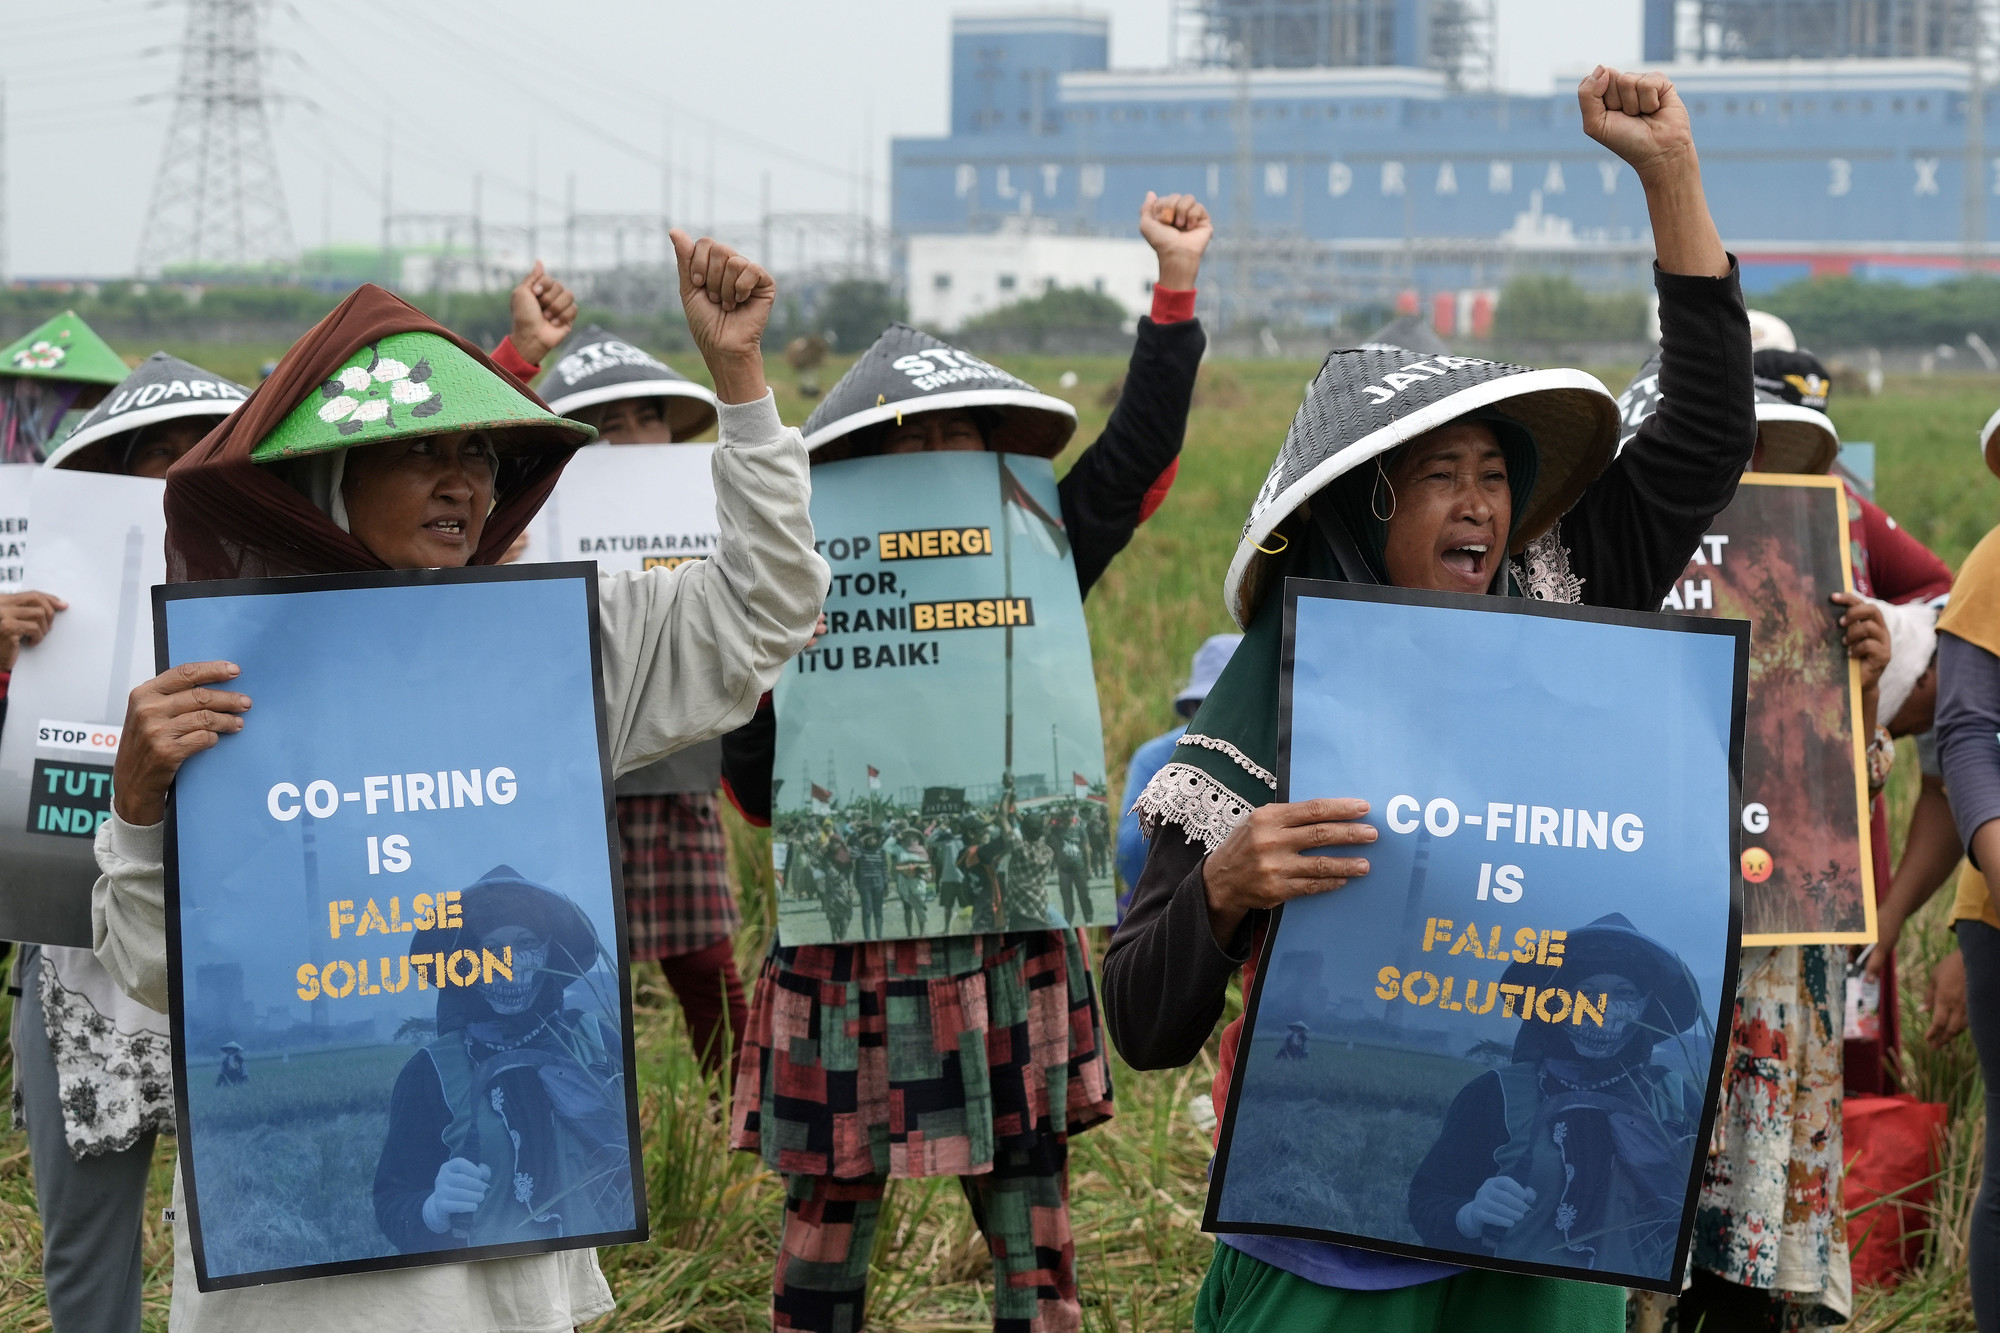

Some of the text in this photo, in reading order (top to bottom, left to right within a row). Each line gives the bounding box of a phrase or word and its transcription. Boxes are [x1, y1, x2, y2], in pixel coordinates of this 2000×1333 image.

[955, 163, 1106, 199] PLTU
[879, 528, 992, 559] ENERGI
[826, 572, 906, 599] TOR,
[914, 600, 1028, 630] BERSIH
[853, 641, 939, 669] BAIK!
[40, 728, 86, 744] STOP
[44, 768, 115, 798] TUT
[267, 767, 517, 821] CO-FIRING
[1386, 794, 1644, 852] CO-FIRING
[367, 834, 412, 874] IS
[1476, 863, 1525, 903] IS
[328, 891, 463, 939] FALSE
[1421, 917, 1568, 967] FALSE
[296, 946, 512, 1002] SOLUTION
[1374, 966, 1608, 1027] SOLUTION
[165, 1211, 175, 1220] M
